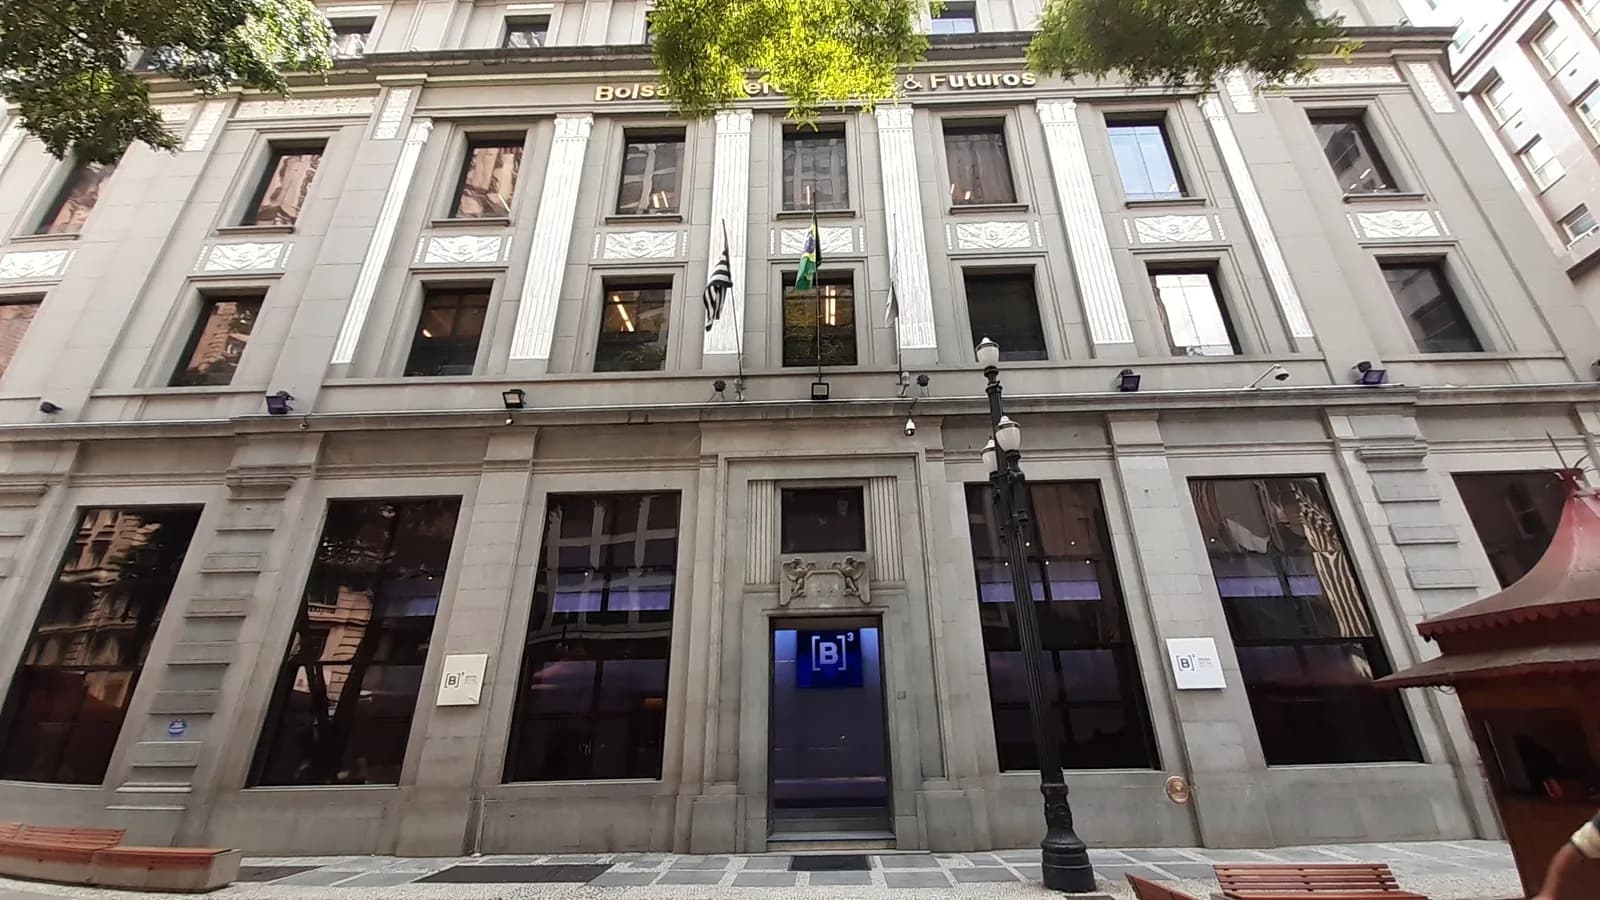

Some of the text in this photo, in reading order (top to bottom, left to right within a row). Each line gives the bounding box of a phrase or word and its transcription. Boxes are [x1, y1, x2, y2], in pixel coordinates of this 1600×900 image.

[595, 71, 1037, 101] Bolsa & Futuros
